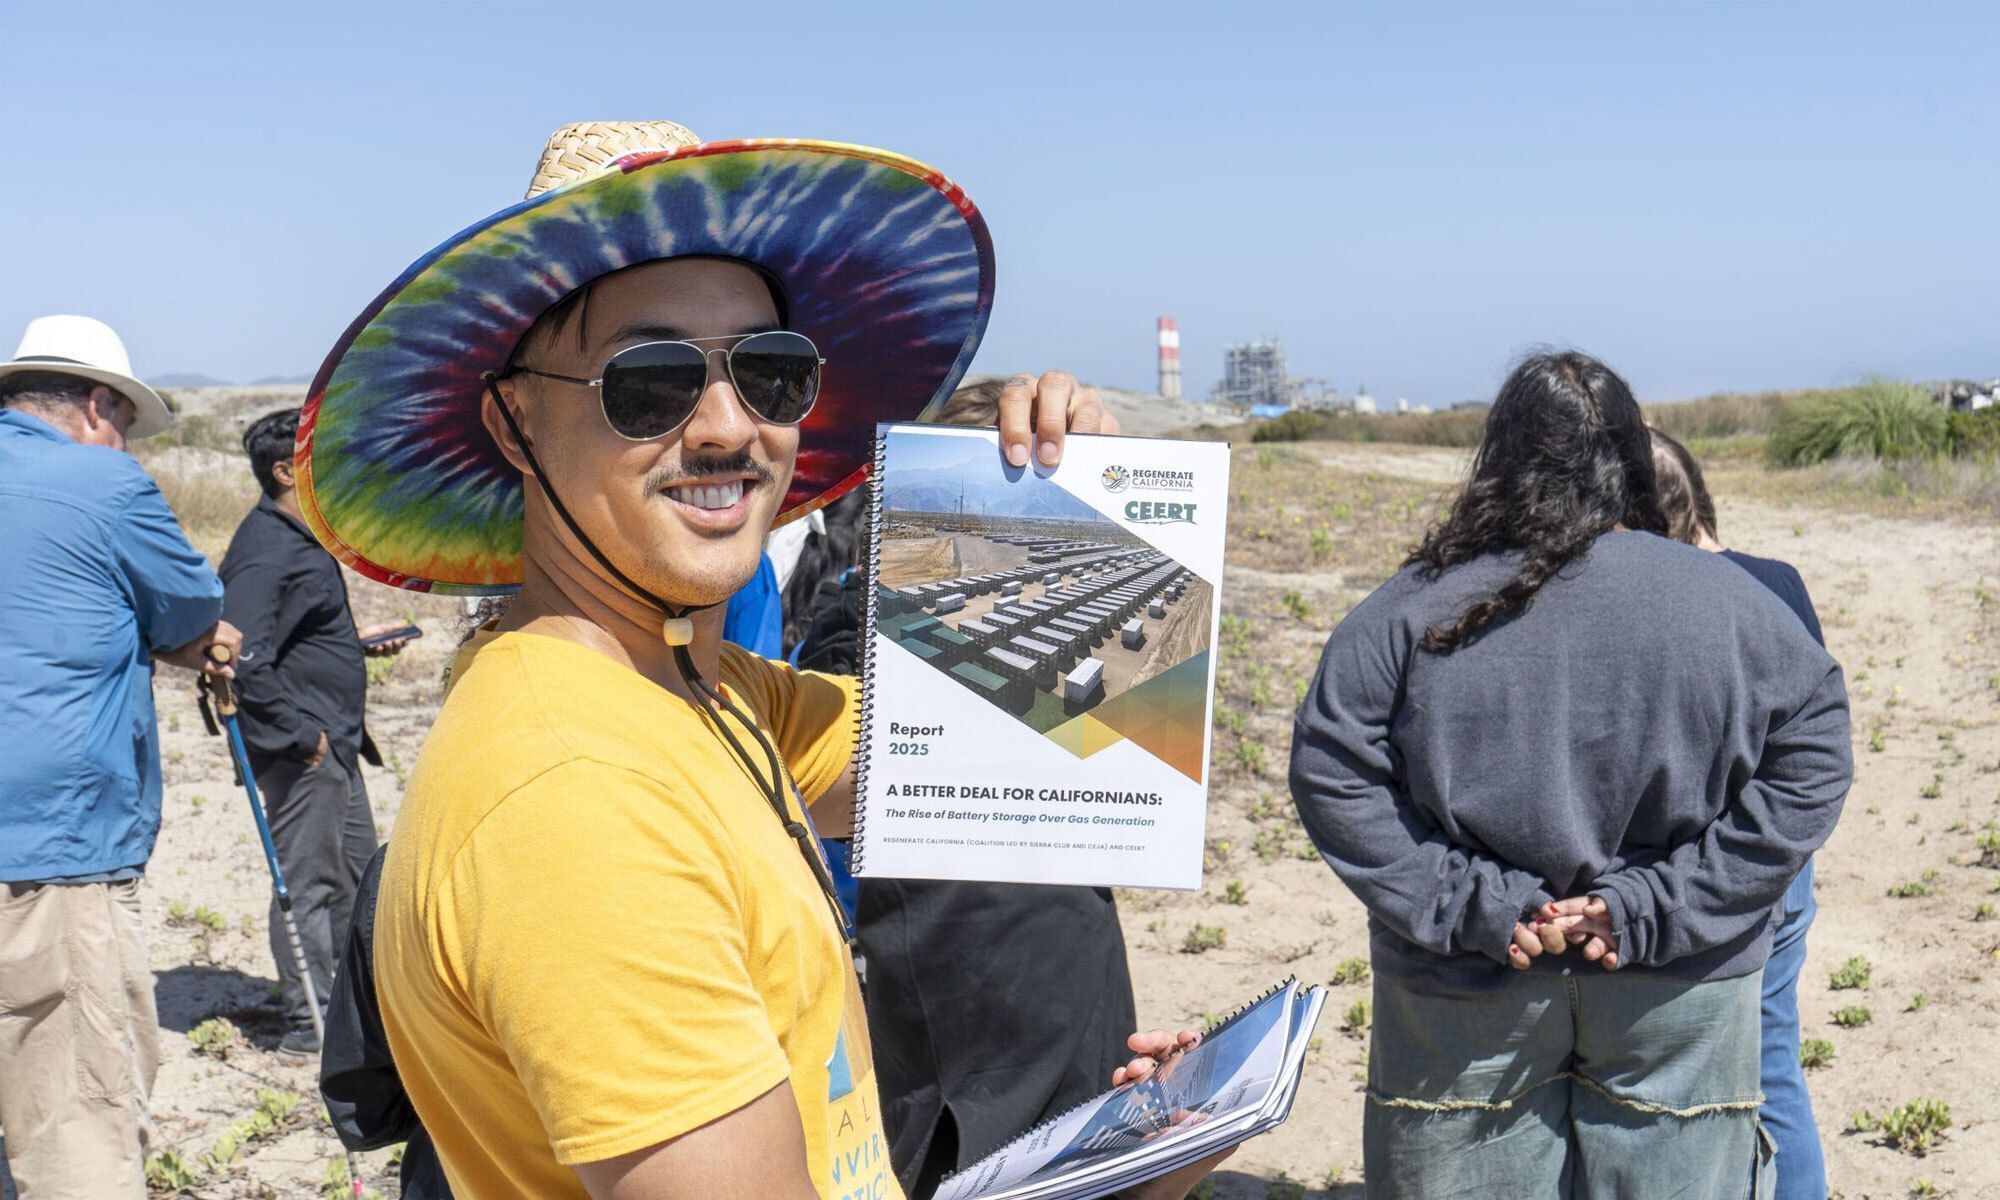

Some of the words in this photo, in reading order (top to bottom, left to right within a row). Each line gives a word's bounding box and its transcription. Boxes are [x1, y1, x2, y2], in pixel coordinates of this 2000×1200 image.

[1132, 469, 1194, 480] REGENERATE
[1132, 478, 1193, 488] CALIFORNIA
[1124, 500, 1197, 521] CEERT
[890, 722, 944, 739] Report
[889, 743, 929, 755] 2025
[886, 784, 898, 796] A
[903, 785, 955, 798] BETTER
[960, 787, 999, 799] DEAL
[1003, 788, 1034, 800] FOR
[1039, 789, 1162, 805] CALIFORNIANS:
[886, 808, 905, 818] The
[908, 808, 932, 819] Rise
[934, 809, 946, 819] of
[947, 810, 990, 824] Battery
[992, 812, 1036, 825] Storage
[1039, 813, 1066, 823] Over
[1068, 814, 1089, 824] Gas
[1092, 815, 1154, 827] Generation
[967, 838, 1005, 847] (COALITION
[1072, 842, 1086, 850] AND
[1088, 842, 1107, 851] CEJA)
[1125, 844, 1145, 852] CEERT
